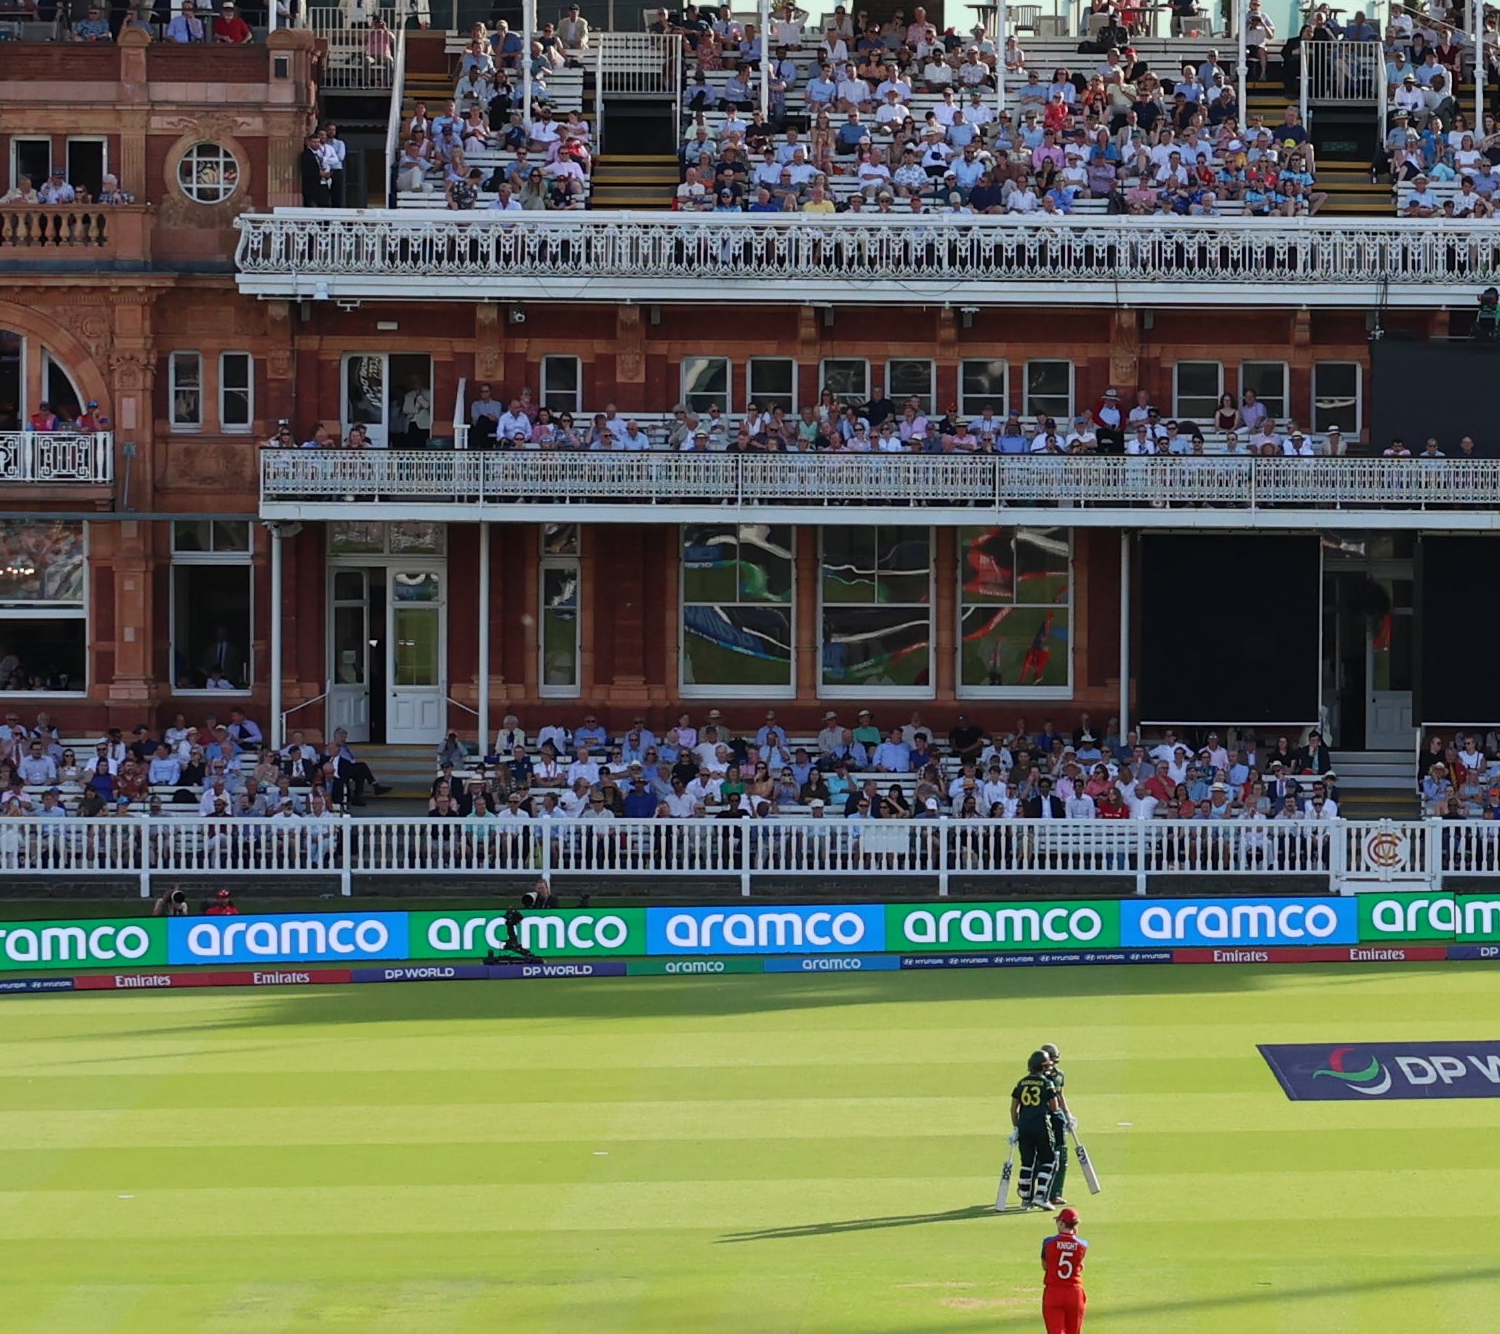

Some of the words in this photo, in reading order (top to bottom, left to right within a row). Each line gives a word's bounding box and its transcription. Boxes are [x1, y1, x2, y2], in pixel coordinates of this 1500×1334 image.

[903, 907, 1102, 943] aramco
[1139, 904, 1338, 940] aramco
[187, 919, 389, 955] aramco
[665, 912, 865, 948] aramco
[1213, 949, 1269, 962] Emirates
[1349, 948, 1405, 961] Emirates
[1480, 947, 1500, 957] DP
[522, 966, 542, 977] DP
[543, 965, 593, 976] WORLD
[665, 961, 725, 973] aramco
[802, 958, 862, 970] aramco
[253, 971, 310, 985] Emirates
[385, 969, 404, 980] DP
[406, 967, 455, 979] WORLD
[114, 974, 171, 988] Emirates
[1396, 1054, 1469, 1086] DP
[1021, 1086, 1041, 1106] 63
[1057, 1251, 1074, 1280] 5
